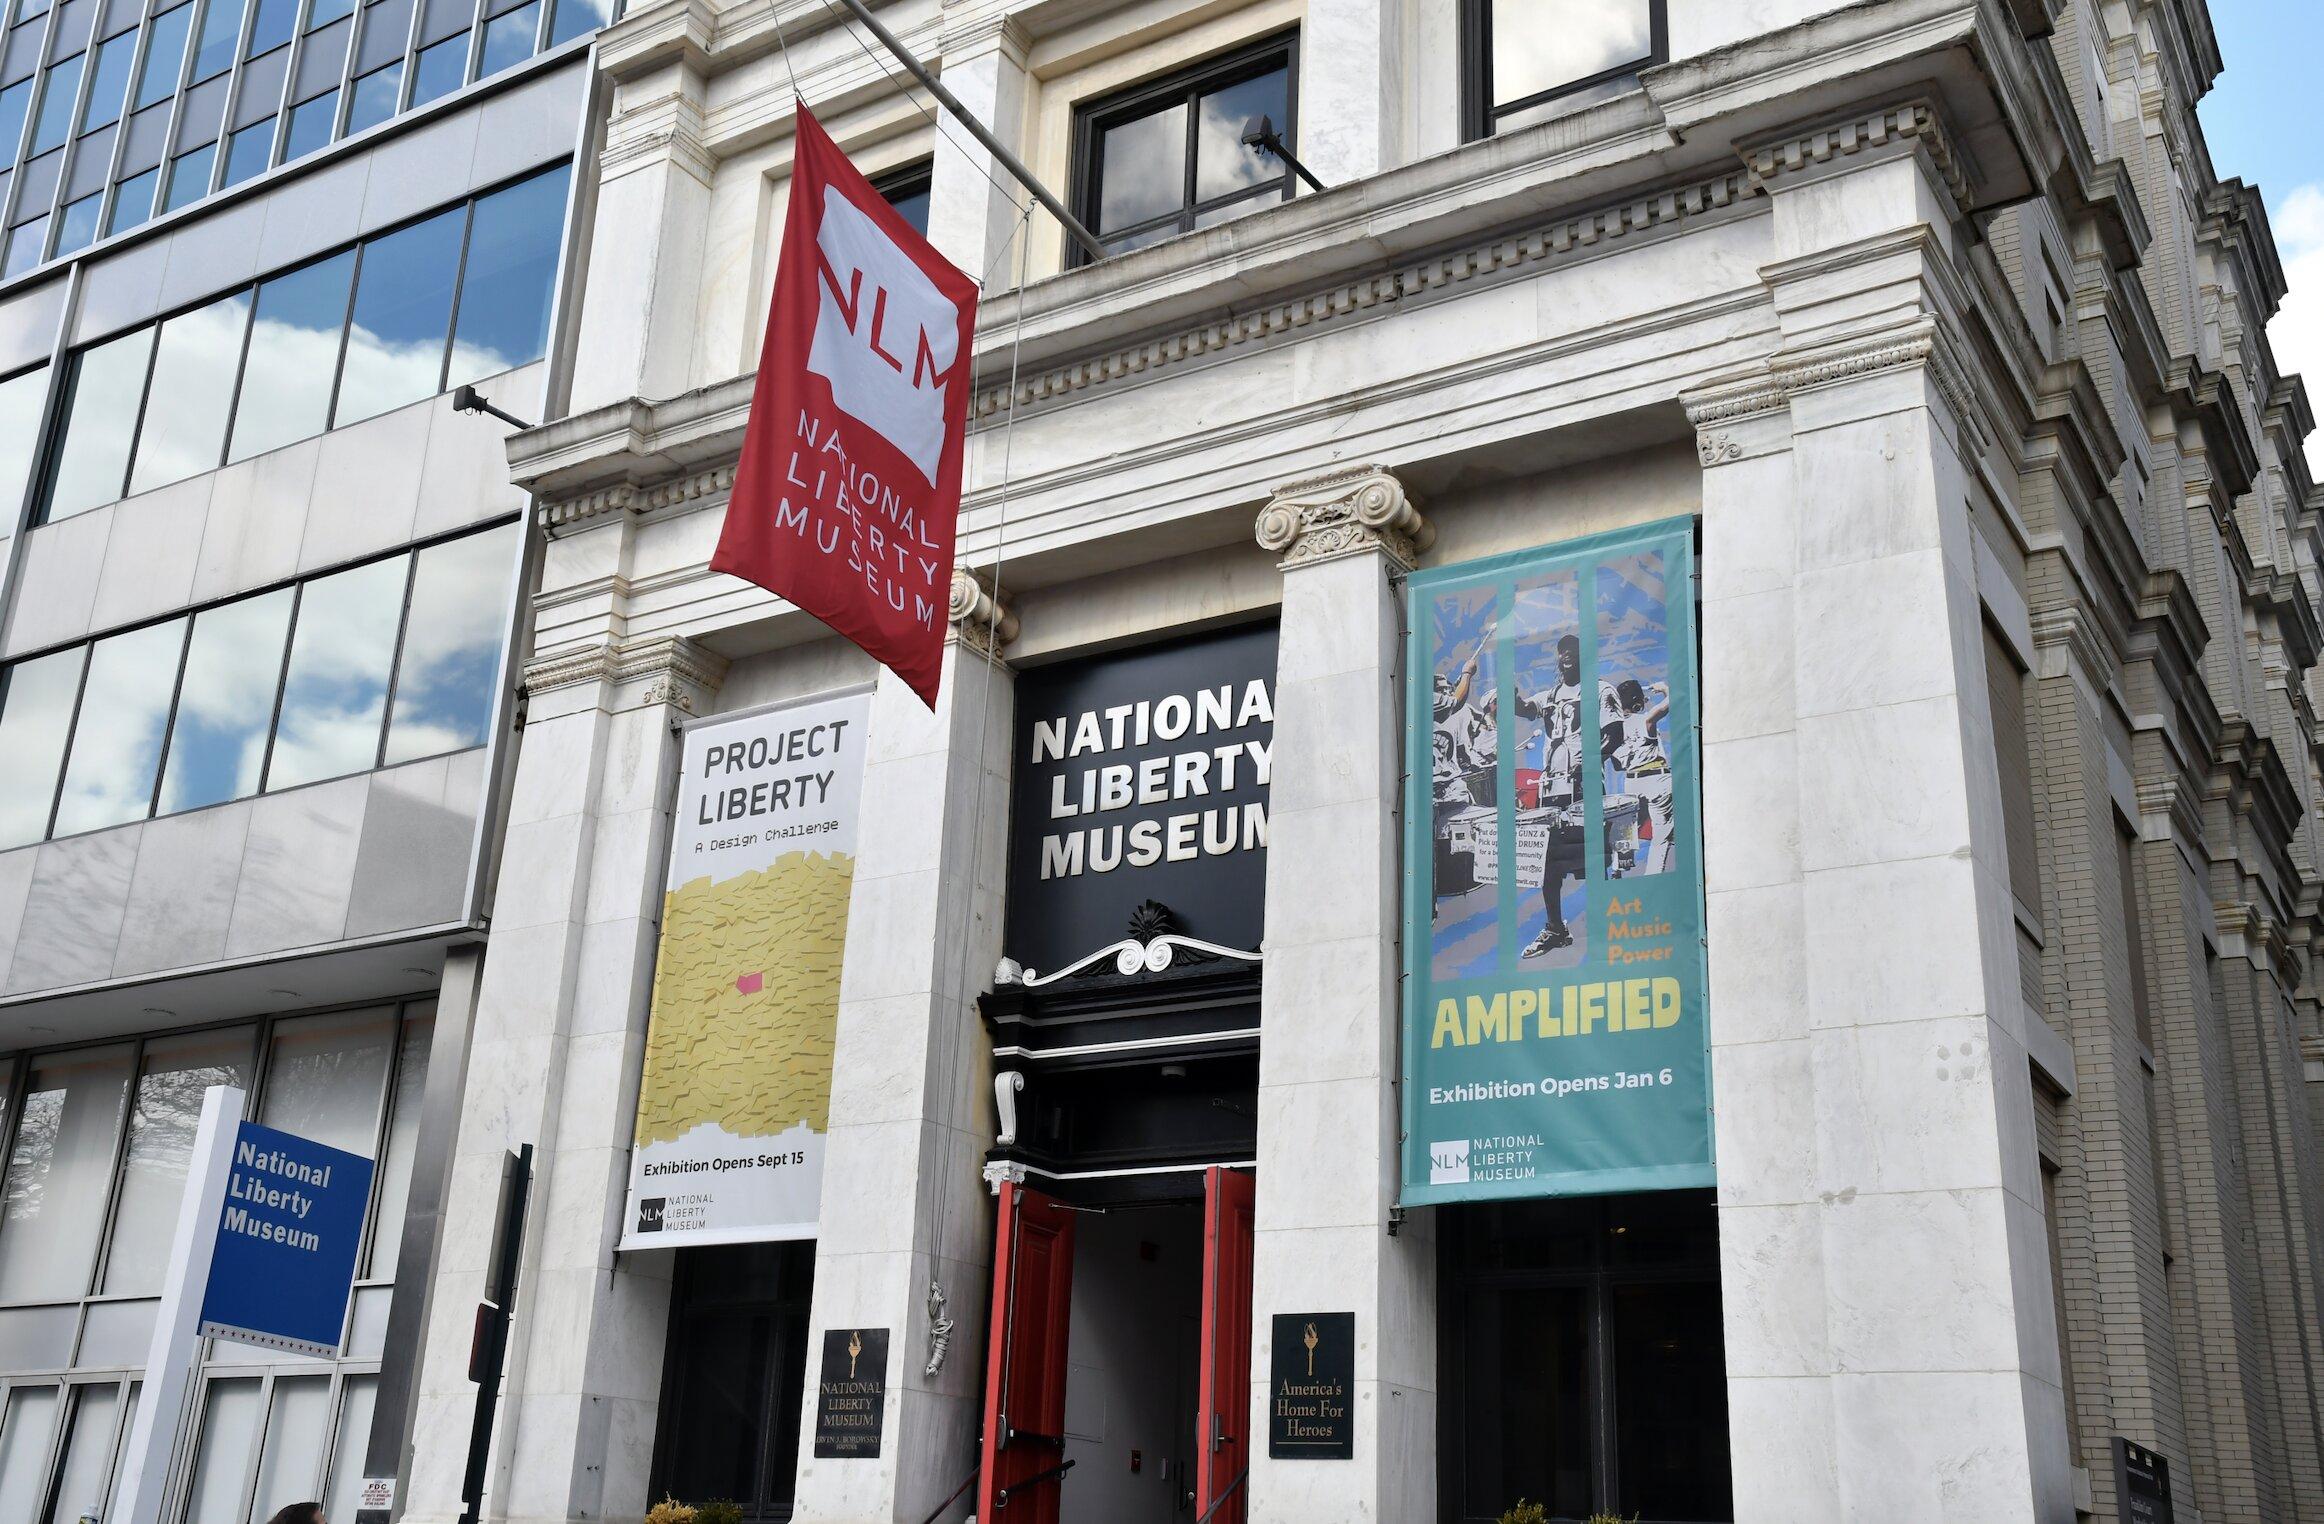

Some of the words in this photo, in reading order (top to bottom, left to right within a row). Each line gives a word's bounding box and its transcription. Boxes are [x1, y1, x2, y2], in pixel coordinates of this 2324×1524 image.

[817, 250, 957, 390] NLM
[799, 408, 940, 549] NATIONAL
[787, 451, 939, 586] LIBERTY
[775, 497, 935, 633] MUSEUM
[1032, 678, 1274, 764] NATIONA
[704, 720, 848, 778] PROJECT
[1051, 739, 1273, 819] LIBERTY
[699, 770, 835, 825] LIBERTY
[695, 842, 703, 853] A
[710, 834, 757, 852] Design
[765, 820, 839, 842] Challenge
[1478, 838, 1490, 846] Pick
[1518, 830, 1538, 838] GUNZ
[1606, 896, 1642, 917] Art
[1607, 914, 1672, 940] Music
[1608, 944, 1674, 966] Power
[1431, 977, 1681, 1049] AMPLIFIED
[1430, 1080, 1535, 1104] Exhibition
[1541, 1075, 1609, 1097] Opens
[1614, 1071, 1653, 1089] Jan
[1659, 1068, 1673, 1086] 6
[1473, 1134, 1545, 1150] NATIONAL
[237, 1141, 331, 1188] National
[644, 1159, 709, 1176] Exhibition
[712, 1156, 754, 1172] Opens
[757, 1153, 787, 1169] Sept
[791, 1151, 804, 1166] 15
[1430, 1154, 1469, 1170] NLM
[1473, 1151, 1533, 1166] LIBERTY
[1473, 1167, 1535, 1181] MUSEUM
[230, 1173, 313, 1219] Liberty
[668, 1194, 714, 1206] NATIONAL
[640, 1208, 664, 1222] NLM
[667, 1208, 706, 1219] LIBERTY
[223, 1206, 320, 1251] Museum
[665, 1220, 706, 1231] MUSEUM
[821, 1382, 882, 1394] NATIONAL
[1279, 1377, 1342, 1396] America's
[828, 1398, 873, 1410] LIBERTY
[1277, 1399, 1316, 1417] Home
[1320, 1400, 1344, 1418] For
[823, 1414, 874, 1426] MUSEUM
[1286, 1419, 1333, 1437] Heroes
